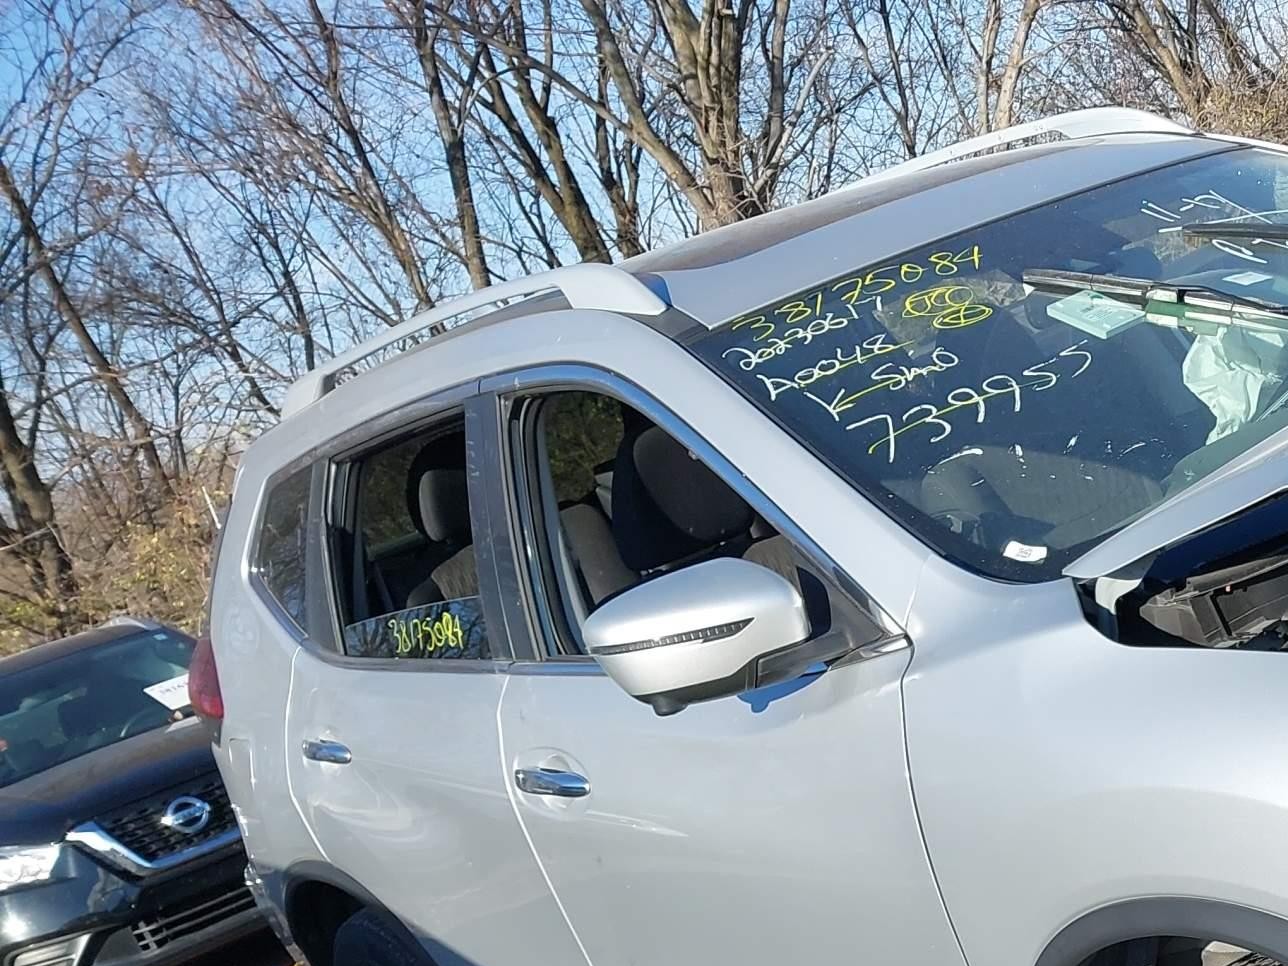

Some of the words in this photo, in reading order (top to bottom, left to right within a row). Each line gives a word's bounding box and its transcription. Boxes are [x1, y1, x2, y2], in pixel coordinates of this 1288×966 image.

[732, 246, 983, 341] 38175084
[846, 339, 1093, 463] 739955
[388, 611, 464, 653] 38175084
